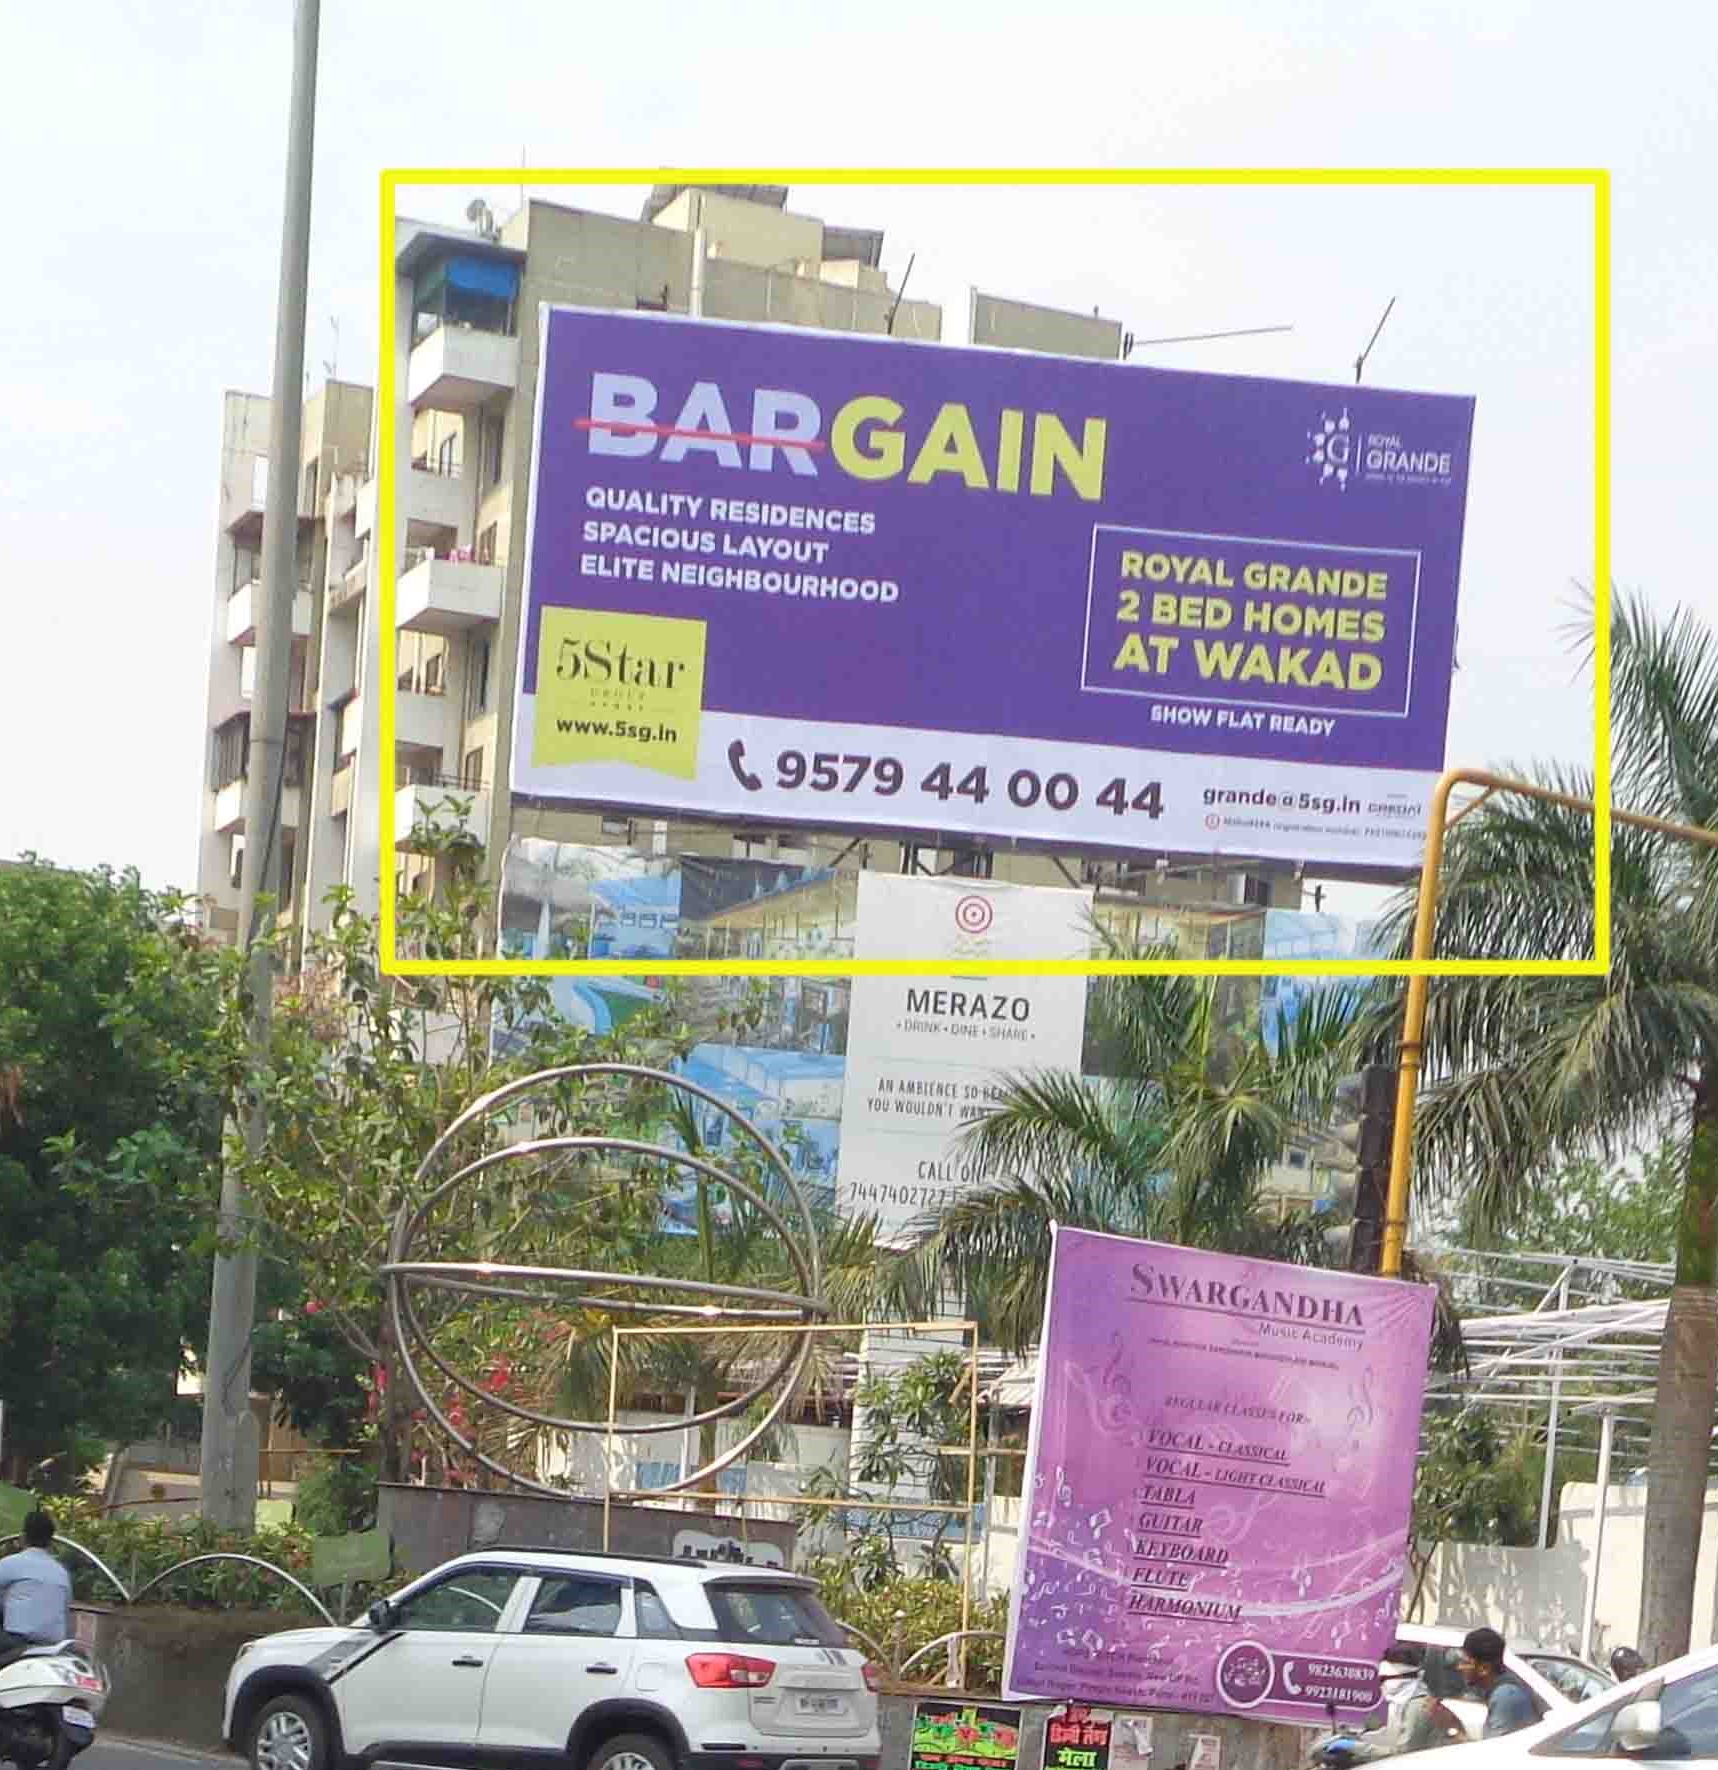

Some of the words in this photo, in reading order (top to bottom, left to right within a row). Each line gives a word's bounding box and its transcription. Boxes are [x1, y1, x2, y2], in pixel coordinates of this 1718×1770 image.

[588, 373, 1107, 501] BARGAIN
[1368, 434, 1401, 448] ROYAL
[1366, 450, 1452, 474] GRANDE
[585, 487, 703, 519] QUALITY
[710, 498, 876, 534] RESIDENCES
[583, 521, 716, 553] SPACIOUS
[723, 532, 830, 564] LAYOUT
[580, 554, 654, 581] ELITE
[661, 562, 899, 602] NEIGHBOURHOOD
[1121, 551, 1234, 588] ROYAL
[1243, 562, 1388, 600] GRANDE
[1117, 590, 1140, 622] 2
[1151, 593, 1232, 631] BED
[1243, 601, 1386, 642] HOMES
[555, 637, 686, 690] 5Star
[1113, 633, 1179, 673] AT
[1193, 639, 1384, 691] WAKAD
[556, 718, 677, 744] www.5sg.in
[1151, 705, 1212, 727] SHOW
[1217, 710, 1262, 731] FLAT
[1269, 714, 1336, 737] READY
[775, 749, 905, 797] 9579
[920, 761, 990, 804] 44
[1006, 768, 1080, 811] 00
[1095, 777, 1165, 820] 44
[906, 988, 1031, 1022] MERAZO
[903, 1021, 941, 1034] DRINK
[951, 1024, 980, 1038] DINE
[988, 1027, 1029, 1042] SHARE
[877, 1079, 894, 1094] AN
[898, 1080, 957, 1099] AMBIENCE
[963, 1084, 979, 1099] SO
[867, 1097, 889, 1113] YOU
[894, 1099, 954, 1118] WOULDN'T
[918, 1161, 953, 1182] CALL
[1131, 1263, 1364, 1327] SWARGANDHA
[1258, 1322, 1298, 1339] Music
[1302, 1329, 1365, 1352] Academy
[1147, 1429, 1204, 1450] VOCAL
[1218, 1440, 1290, 1461] CLASSICAL
[1146, 1457, 1201, 1478] VOCAL
[1214, 1468, 1258, 1484] LIGHT
[1259, 1472, 1326, 1493] CLASSICAL
[1142, 1485, 1196, 1504] TABLA
[1138, 1512, 1203, 1533] GUITAR
[1136, 1538, 1229, 1564] KEYBOARD
[1133, 1567, 1188, 1587] FLUTE
[1129, 1590, 1243, 1619] HARMONIUM
